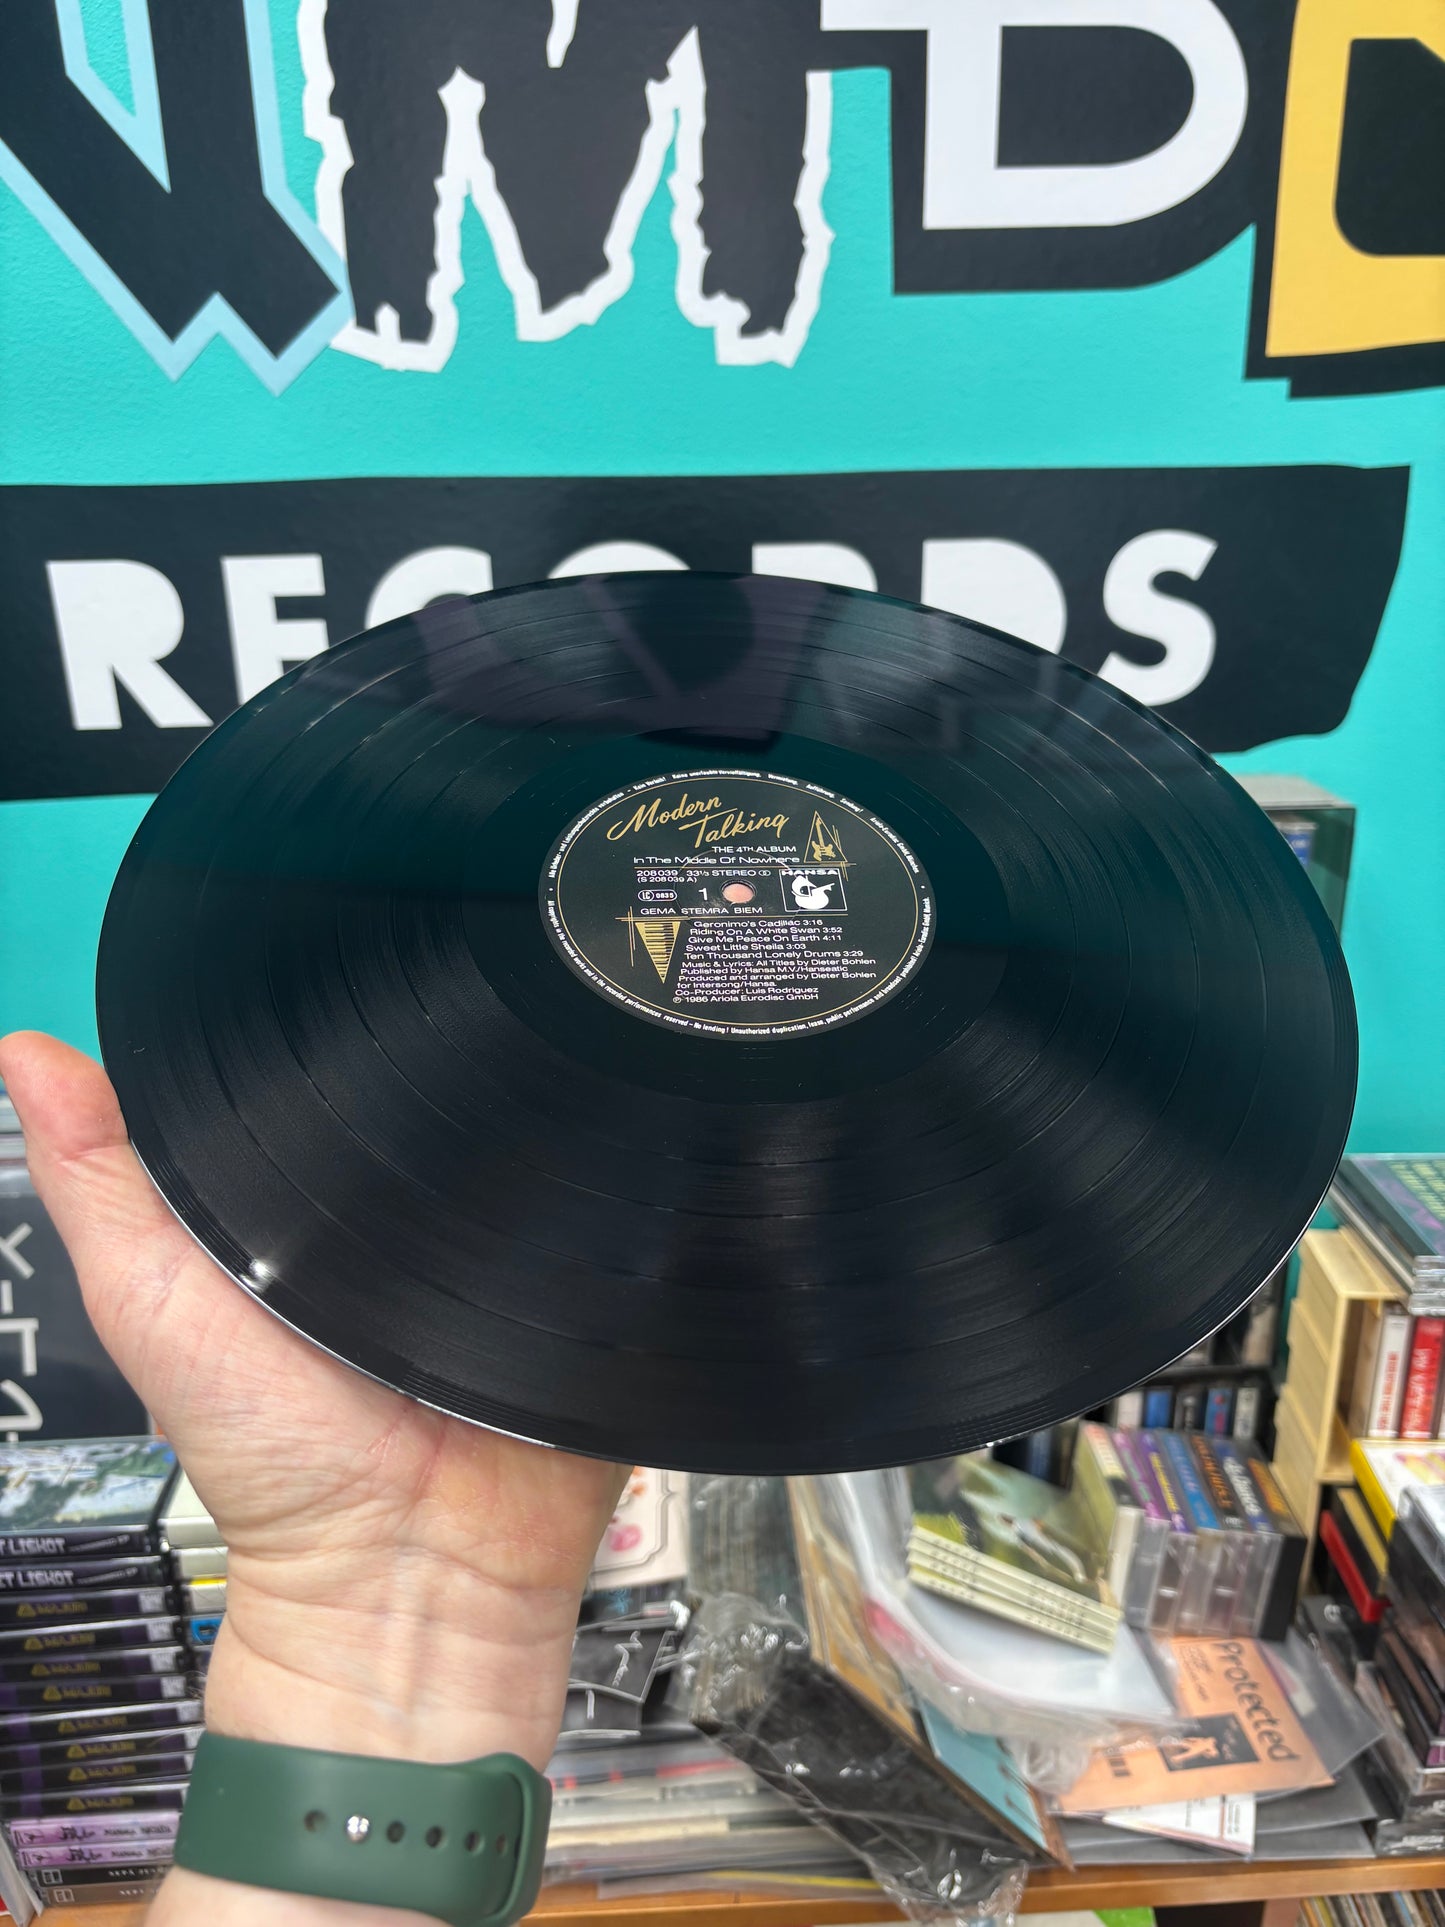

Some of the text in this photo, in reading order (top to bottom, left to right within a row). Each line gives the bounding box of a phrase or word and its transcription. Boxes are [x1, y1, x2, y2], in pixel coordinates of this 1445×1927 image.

[606, 792, 722, 841] Modern
[678, 807, 790, 849] Talking
[755, 845, 797, 853] ALBUM
[633, 856, 800, 864] In The Middle Of Nowhere
[711, 869, 757, 877] STEREO
[698, 887, 708, 901] 1
[640, 907, 676, 915] GEMA
[693, 920, 757, 928] Geronimo's
[758, 919, 801, 927] Cadillac
[689, 928, 724, 936] Riding
[755, 927, 788, 935] White
[789, 926, 821, 934] Swan
[822, 926, 843, 934] 3:52
[688, 936, 713, 944] Give
[735, 935, 771, 943] Peace
[772, 934, 790, 942] On
[791, 934, 821, 942] Earth
[685, 944, 721, 952] Sweet
[683, 952, 705, 960] Ten
[706, 951, 763, 959] Thousand
[764, 951, 802, 959] Lonely
[803, 950, 841, 958] Drums
[722, 960, 754, 969] Lyrics:
[796, 959, 809, 967] by
[730, 967, 743, 975] by
[750, 973, 795, 981] arranged
[796, 972, 809, 980] by
[841, 971, 877, 979] Bohlen
[663, 1014, 689, 1027] reserved
[693, 1021, 702, 1030] No
[730, 1026, 771, 1035] Unauthorized
[1213, 1641, 1299, 1761] Protected
